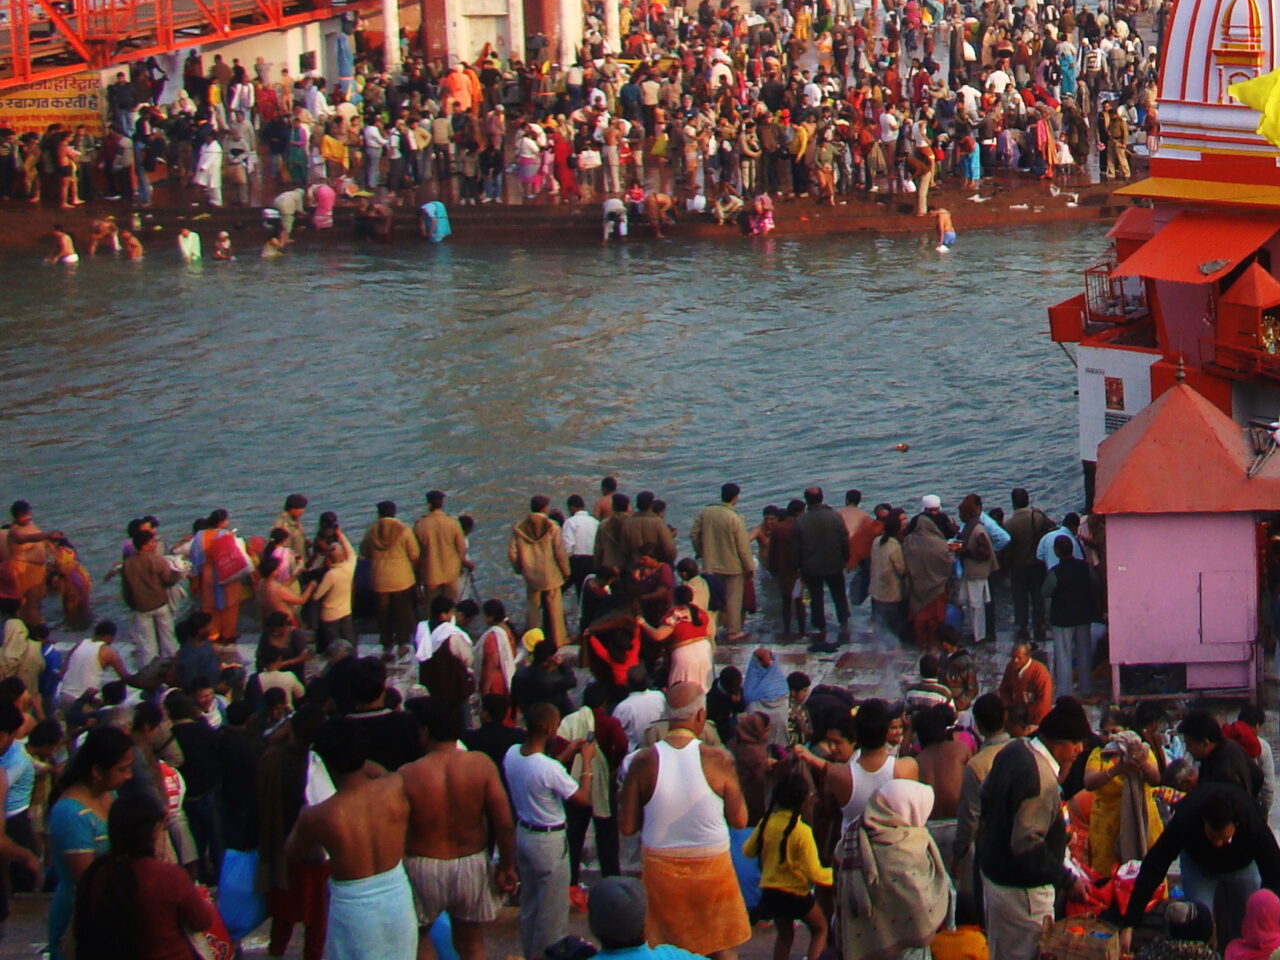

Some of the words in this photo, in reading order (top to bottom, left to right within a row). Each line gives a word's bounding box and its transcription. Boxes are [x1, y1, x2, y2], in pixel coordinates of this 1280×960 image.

[54, 76, 102, 92] हरिद्वार
[6, 98, 49, 109] स्वागत
[51, 94, 86, 109] करती
